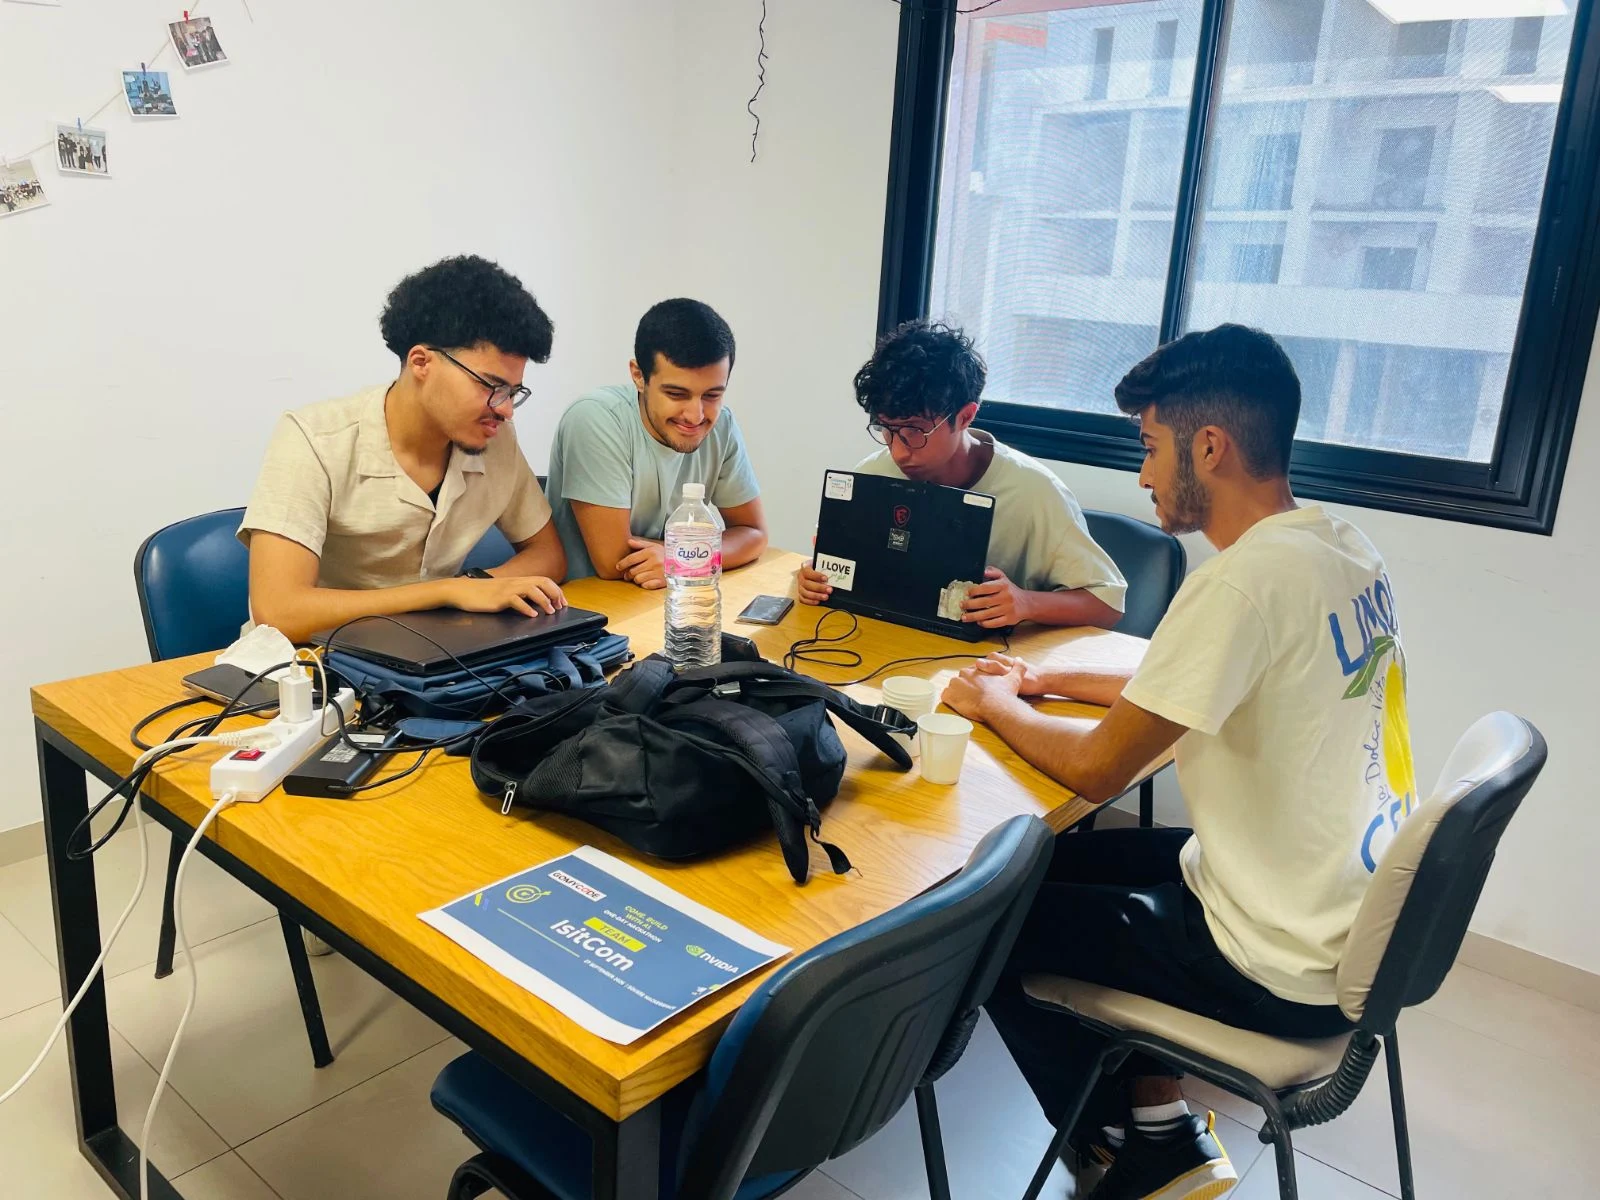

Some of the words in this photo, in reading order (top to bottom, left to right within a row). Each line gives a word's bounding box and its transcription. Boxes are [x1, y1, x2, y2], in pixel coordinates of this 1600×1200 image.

[678, 547, 709, 560] صافية
[821, 560, 825, 569] I
[826, 561, 851, 575] LOVE
[1363, 719, 1382, 785] Dolce
[553, 872, 600, 898] GOMYCODE
[550, 919, 634, 972] IsitCom
[599, 925, 630, 944] TEAM
